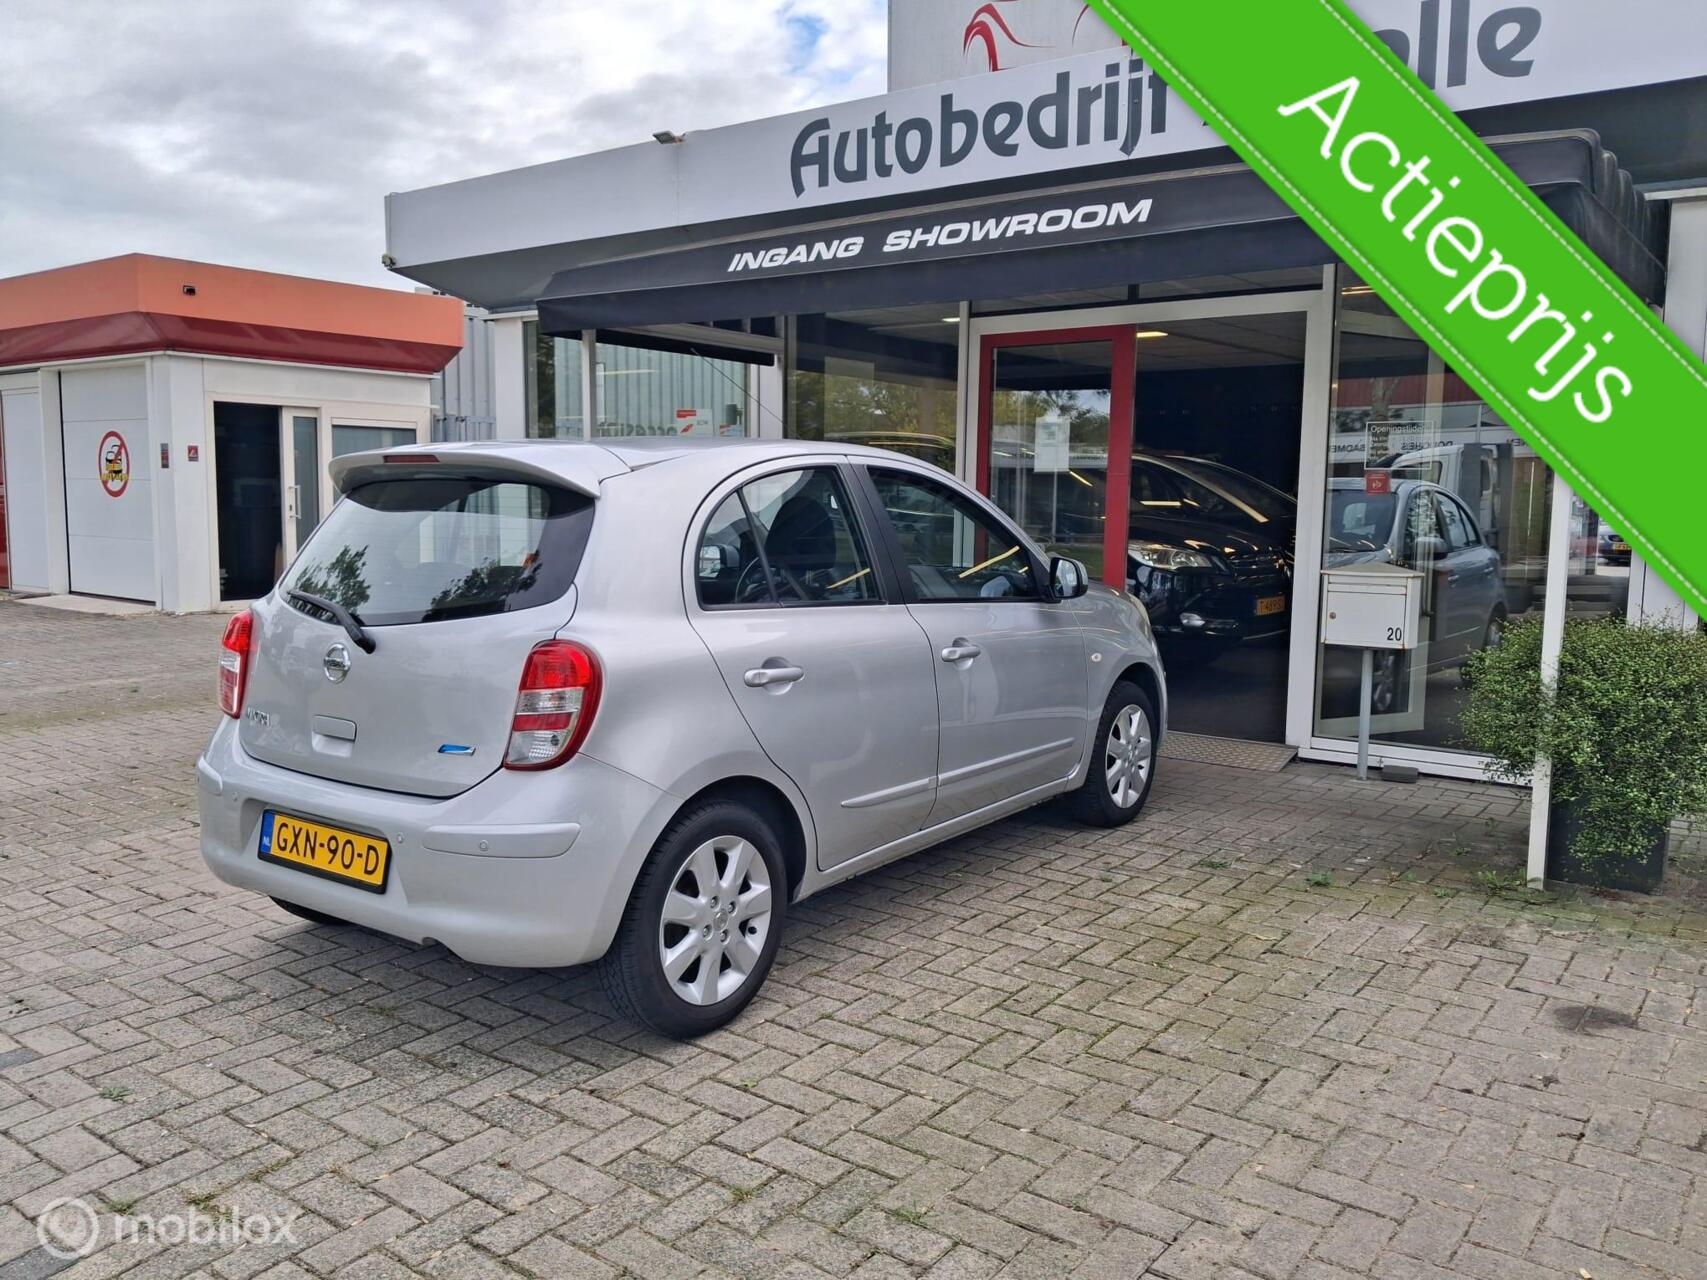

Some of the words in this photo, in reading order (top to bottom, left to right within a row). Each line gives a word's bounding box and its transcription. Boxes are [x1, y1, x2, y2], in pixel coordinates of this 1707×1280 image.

[790, 58, 1168, 198] Autobedrijf
[727, 236, 864, 272] INGANG
[882, 199, 1153, 253] SHOWROOM
[1387, 627, 1403, 642] 20
[277, 823, 379, 875] GXN-90-D
